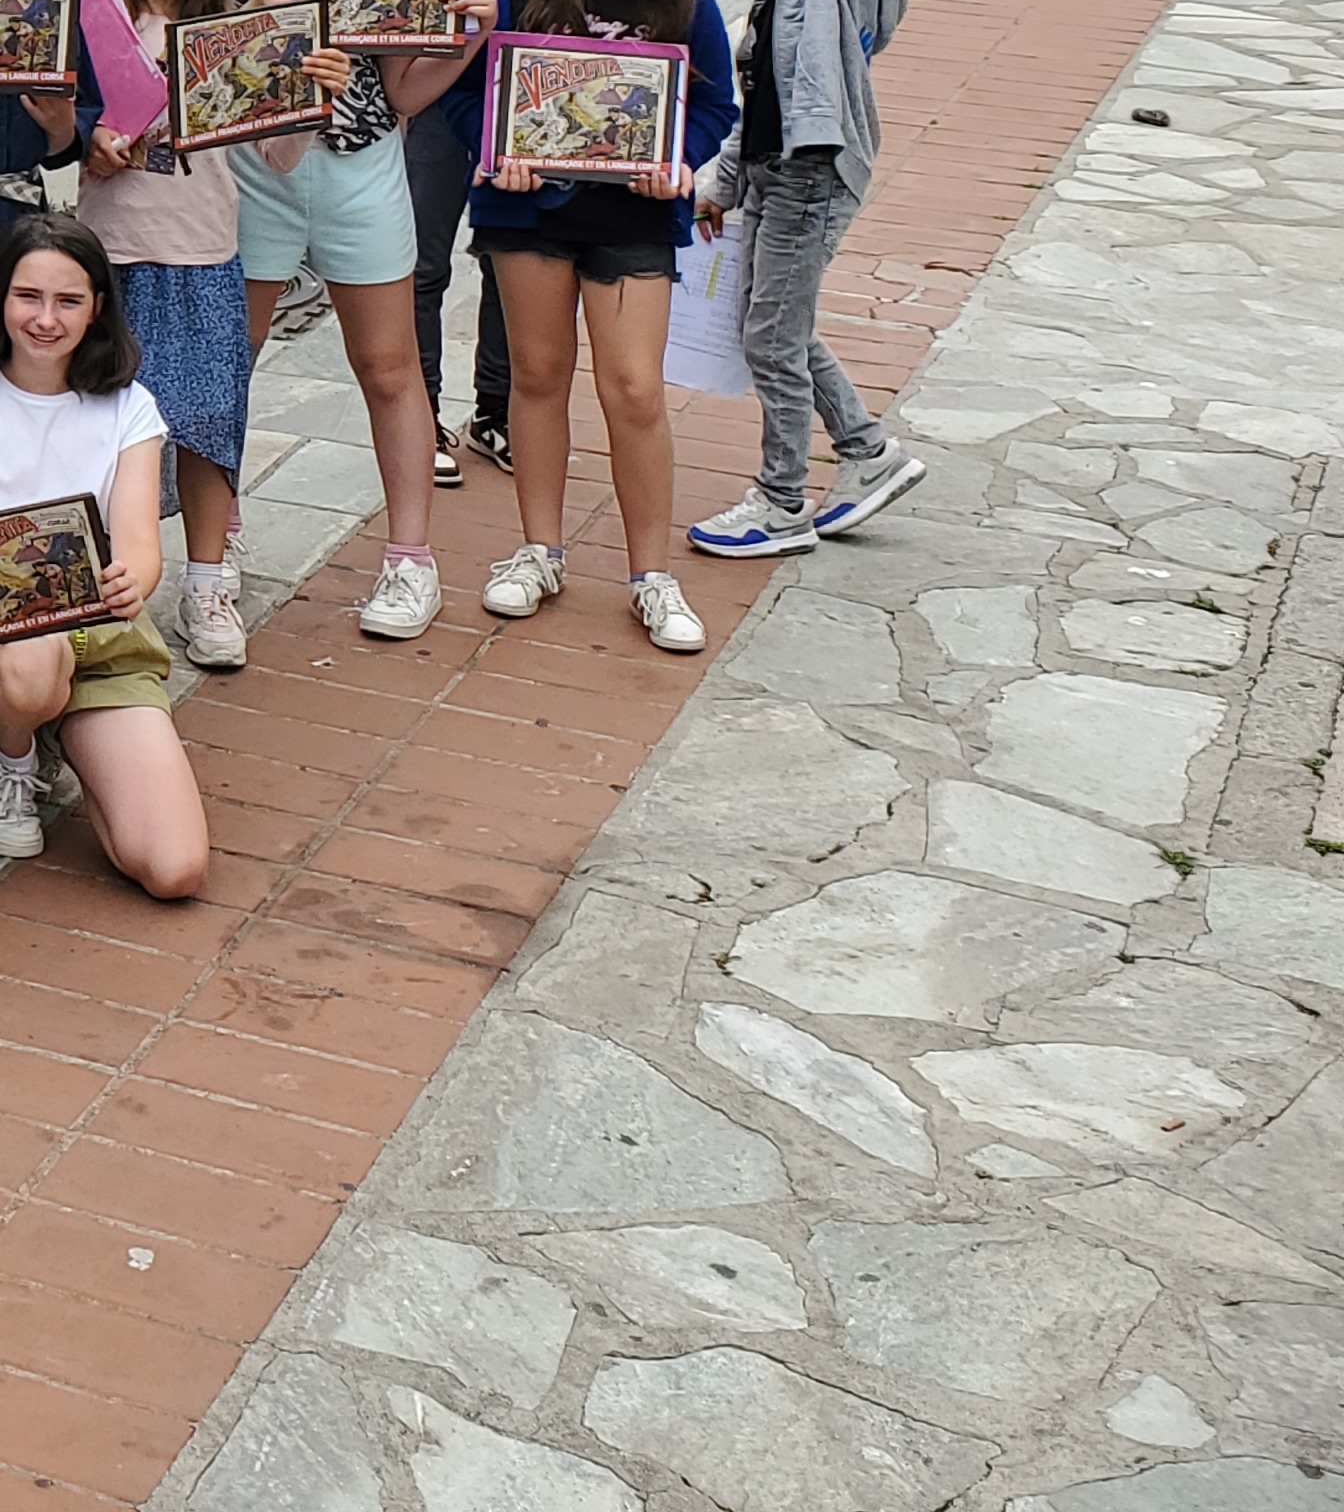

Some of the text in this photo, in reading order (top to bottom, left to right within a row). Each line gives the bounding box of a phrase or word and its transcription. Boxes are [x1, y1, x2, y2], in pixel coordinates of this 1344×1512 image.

[184, 13, 280, 84] VENDETTA
[518, 58, 624, 110] VENDETTA
[50, 606, 84, 622] LANGUE
